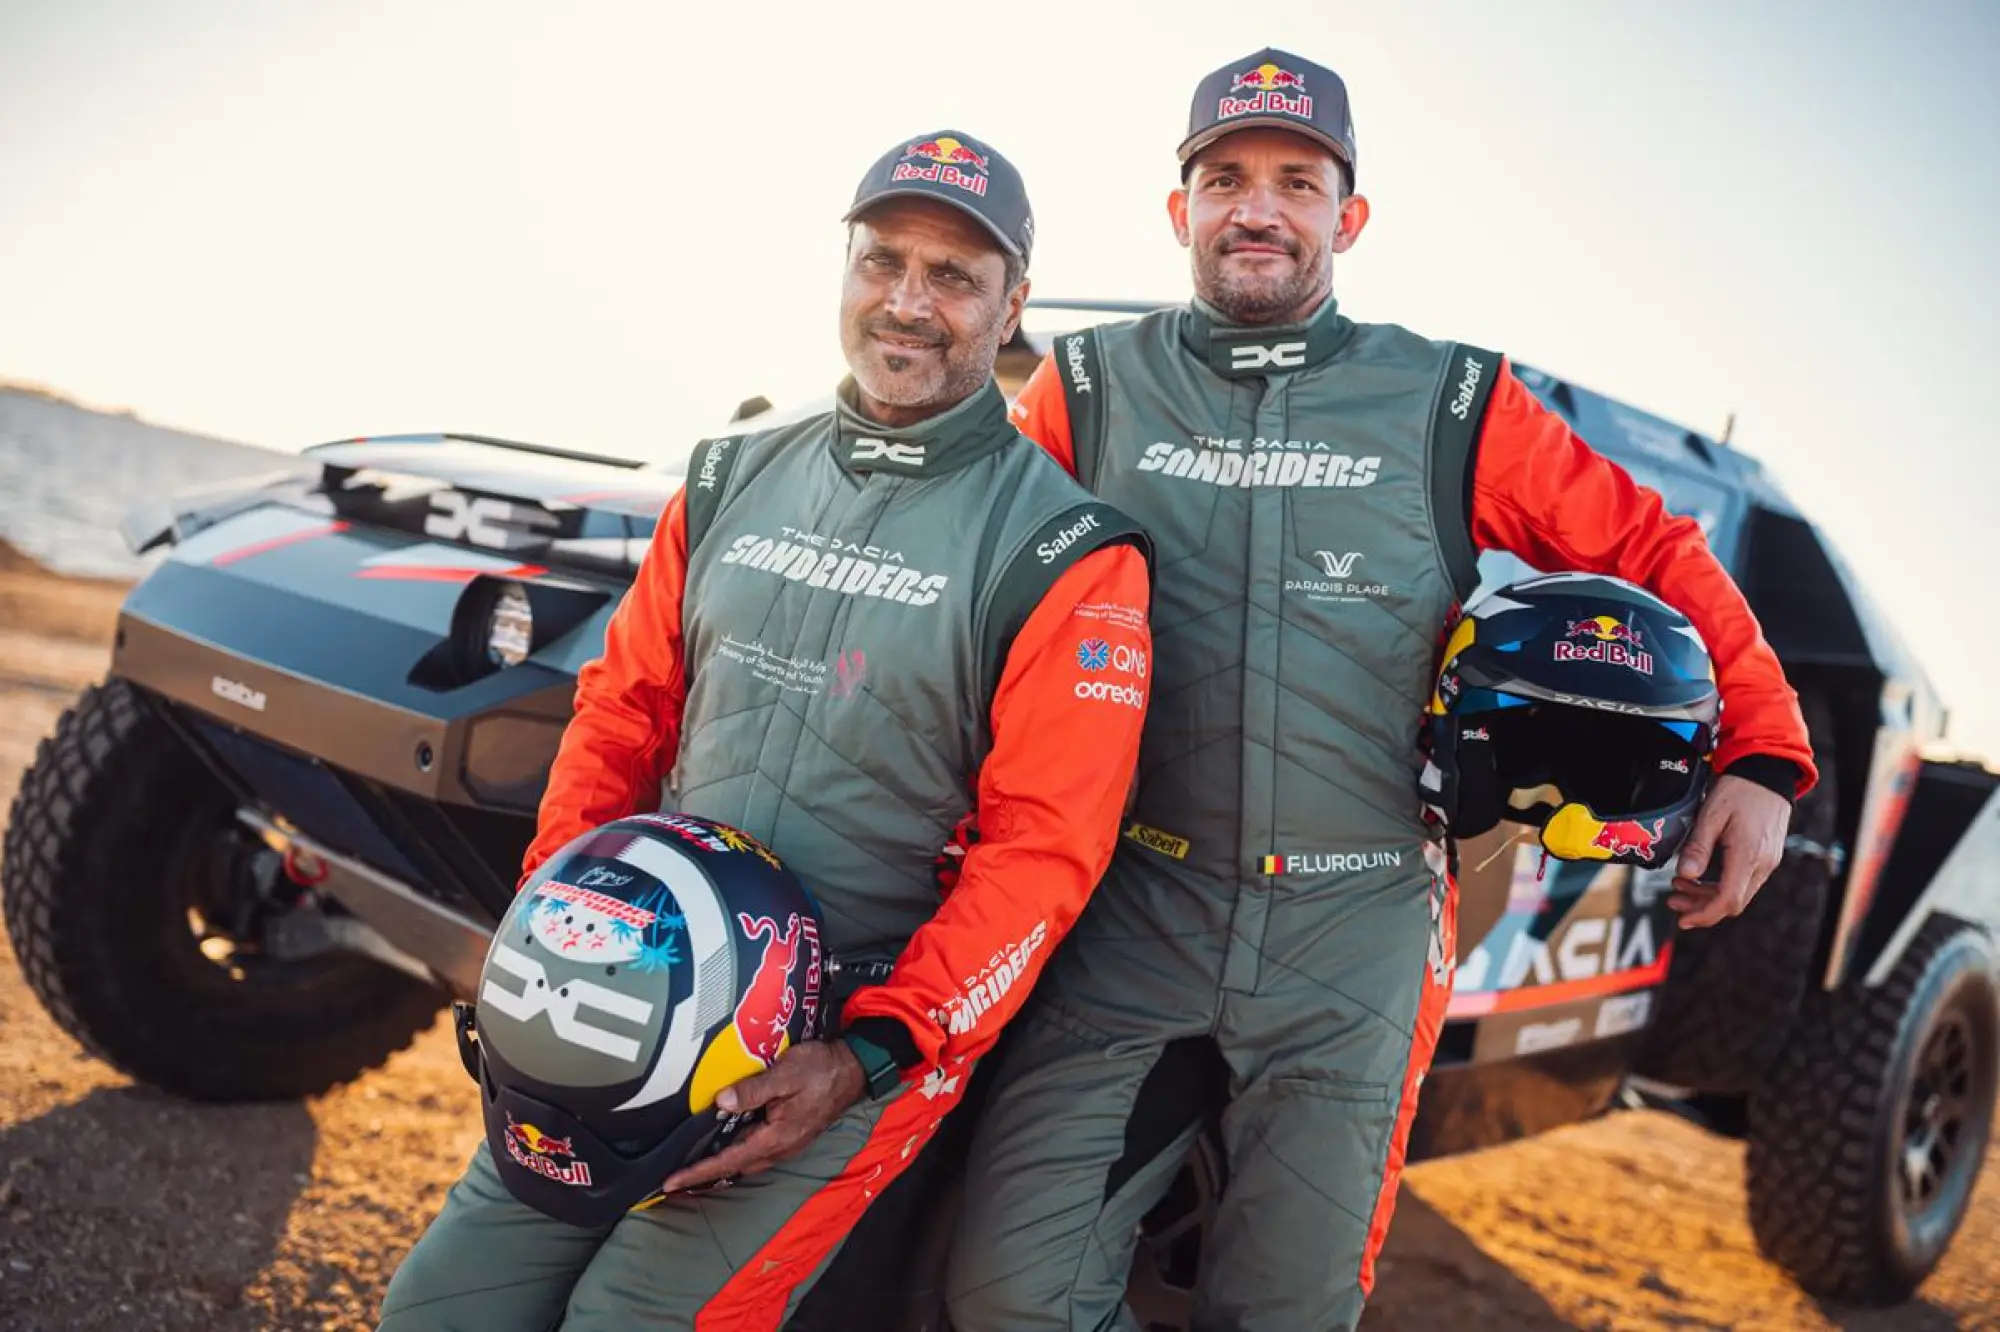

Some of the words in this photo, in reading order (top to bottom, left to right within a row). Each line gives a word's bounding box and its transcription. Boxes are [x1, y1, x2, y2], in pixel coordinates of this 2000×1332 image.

[1218, 91, 1265, 120] Red
[1267, 91, 1313, 119] Bull
[892, 162, 941, 182] Red
[940, 164, 988, 197] Bull
[1066, 336, 1092, 393] Sabelt
[1450, 356, 1483, 420] Sabelt
[1194, 435, 1242, 450] THE
[1252, 437, 1331, 450] DACIA
[697, 440, 730, 492] Sabelt
[1137, 442, 1382, 488] SANDRIDERS
[782, 527, 826, 547] THE
[830, 537, 905, 563] DACIA
[1036, 512, 1100, 565] Sabelt
[720, 534, 949, 607] SANDRIDERS
[1554, 640, 1606, 662] Red
[1607, 643, 1653, 676] Bull
[1554, 692, 1646, 716] DACIA
[1659, 758, 1689, 775] Stilo
[801, 995, 820, 1039] ed
[541, 1153, 592, 1187] Bull
